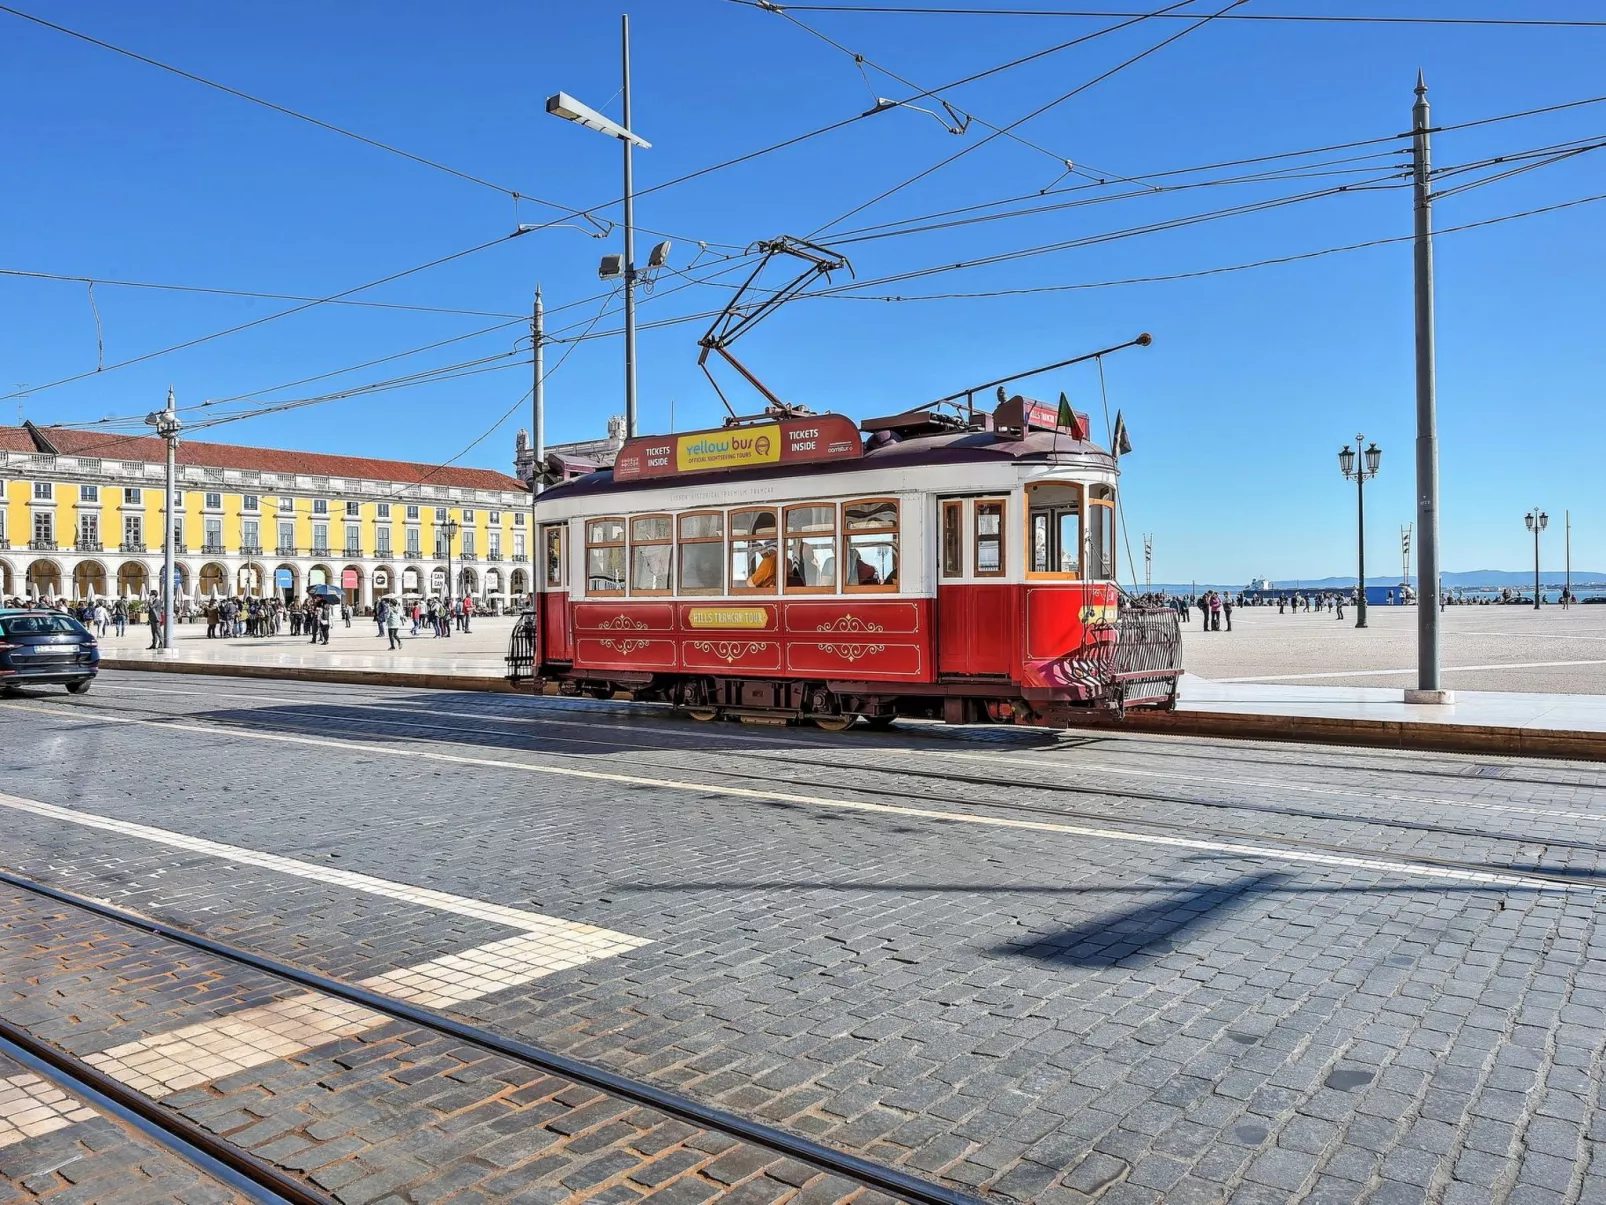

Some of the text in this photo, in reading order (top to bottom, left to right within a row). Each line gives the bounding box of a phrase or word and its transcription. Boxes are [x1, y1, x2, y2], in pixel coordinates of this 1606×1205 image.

[789, 429, 819, 440] TICKETS
[646, 446, 670, 456] TICKETS
[687, 436, 753, 455] yellow bus
[791, 441, 816, 452] INSIDE
[647, 457, 669, 467] INSIDE
[688, 451, 752, 464] OFFICIAL SIGHTSEEING TOURS
[693, 612, 763, 623] HILLS TRAMCAR TOUR
